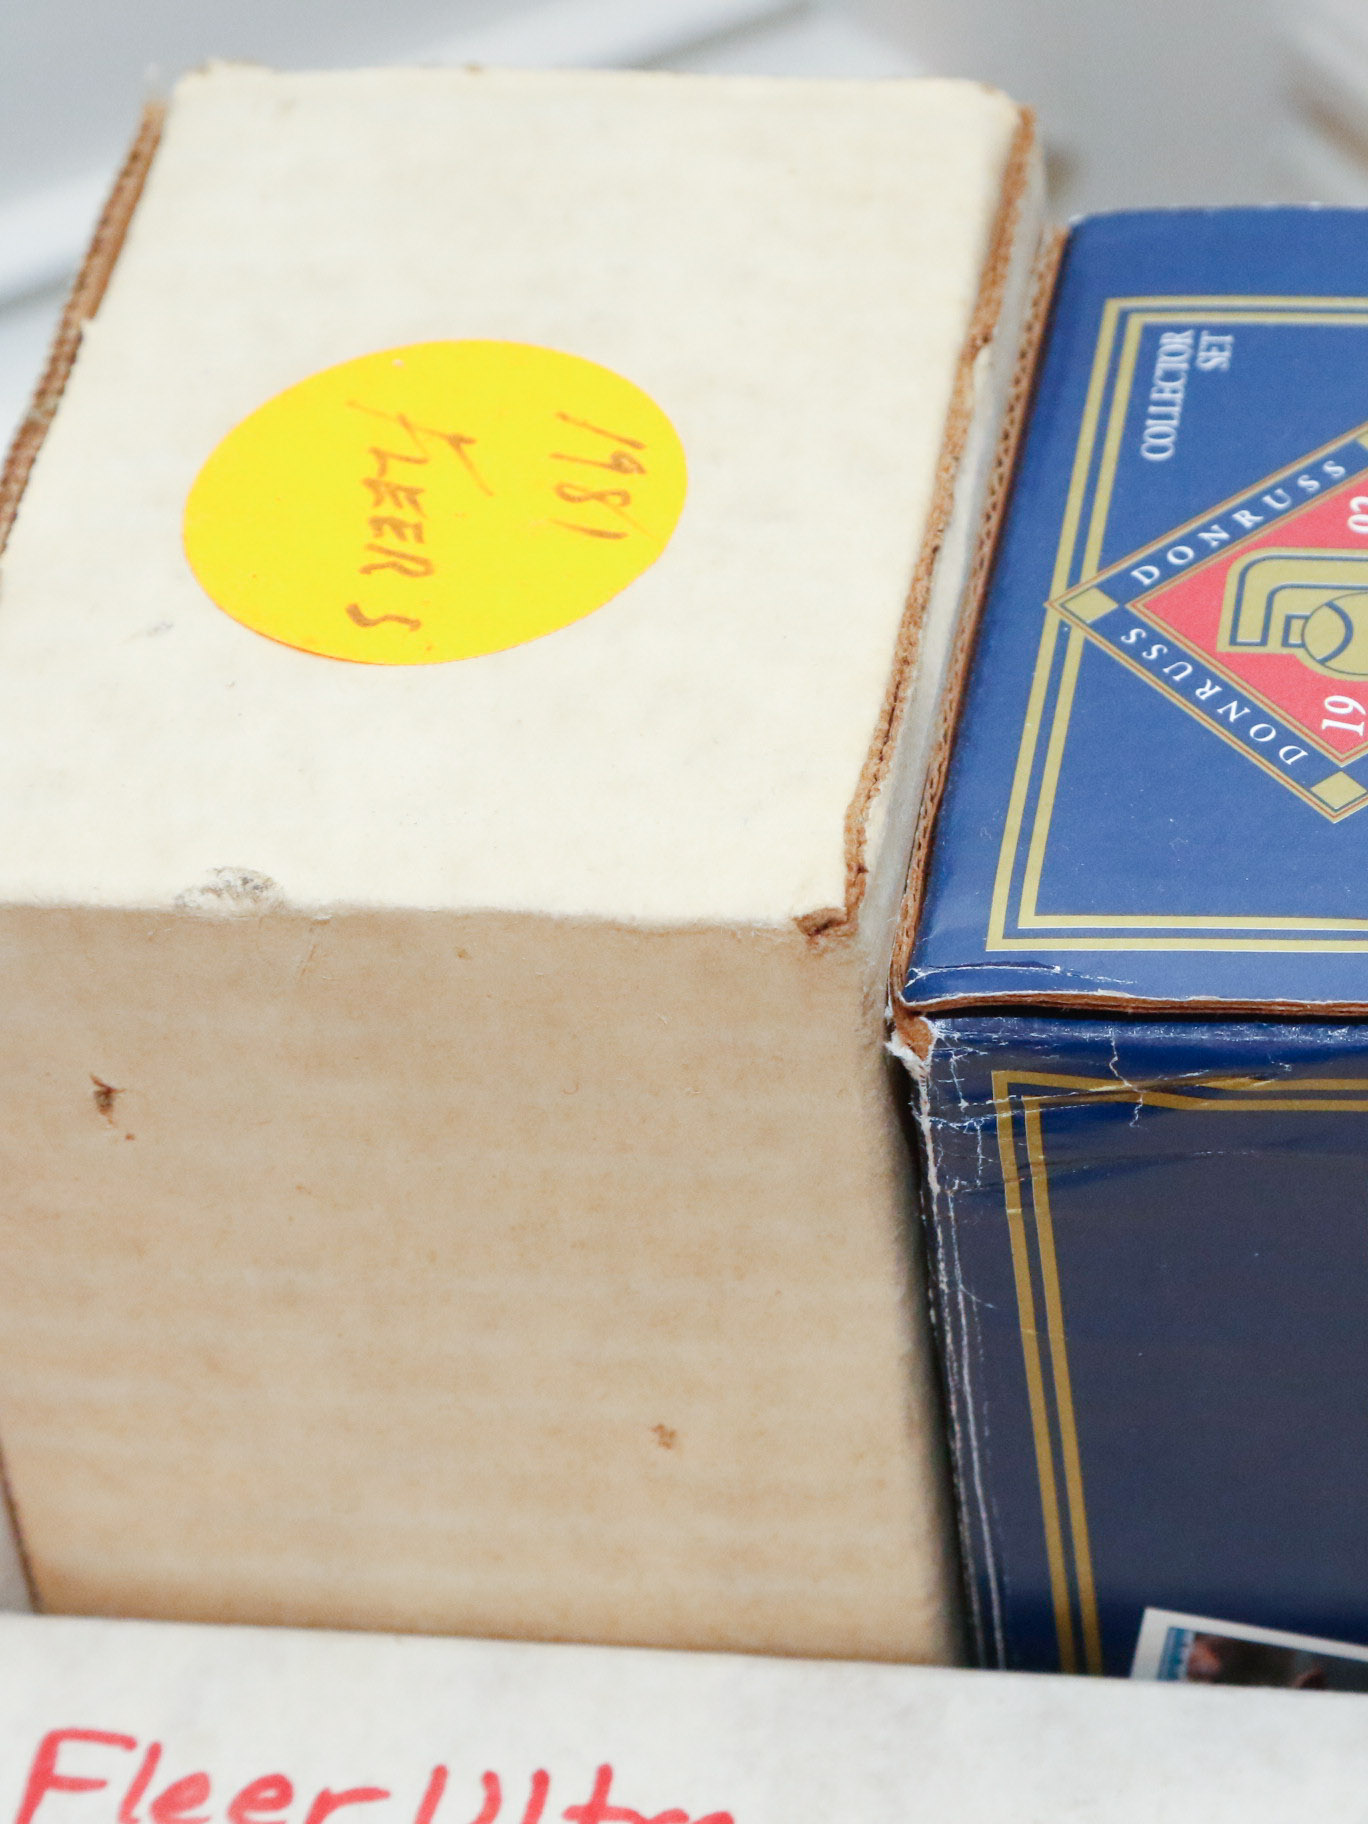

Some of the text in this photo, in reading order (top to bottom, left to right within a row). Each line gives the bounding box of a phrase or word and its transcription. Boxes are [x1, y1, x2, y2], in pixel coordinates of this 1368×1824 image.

[1140, 329, 1194, 462] COLLECTOR
[1196, 331, 1235, 371] SET
[548, 411, 655, 541] 1981
[1131, 459, 1346, 587] DONRUSS
[1120, 627, 1309, 766] DONRUSS
[1320, 693, 1367, 737] 19
[413, 1763, 736, 1824] Ult
